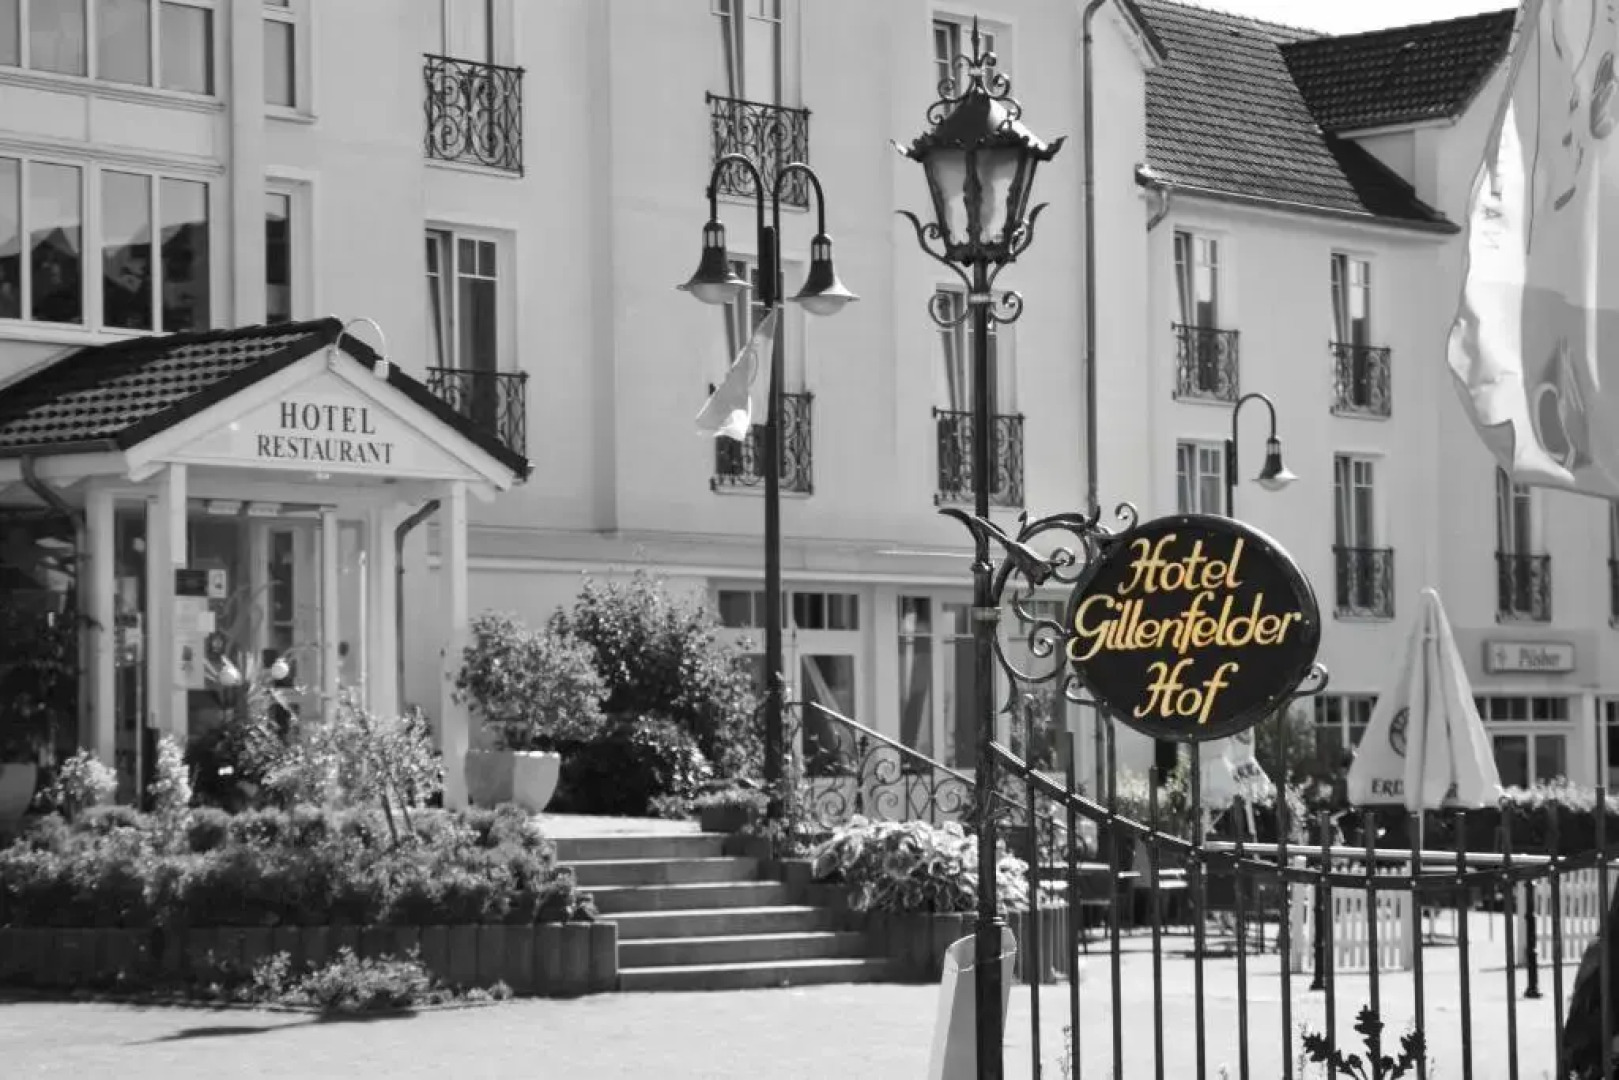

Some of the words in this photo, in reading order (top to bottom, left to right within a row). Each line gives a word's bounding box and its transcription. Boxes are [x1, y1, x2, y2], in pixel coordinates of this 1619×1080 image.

[257, 434, 395, 464] RESTAURANT
[280, 402, 376, 434] HOTEL
[1117, 533, 1244, 595] Hotel
[1065, 590, 1302, 661] Gillenfelder
[1133, 657, 1239, 725] Hof
